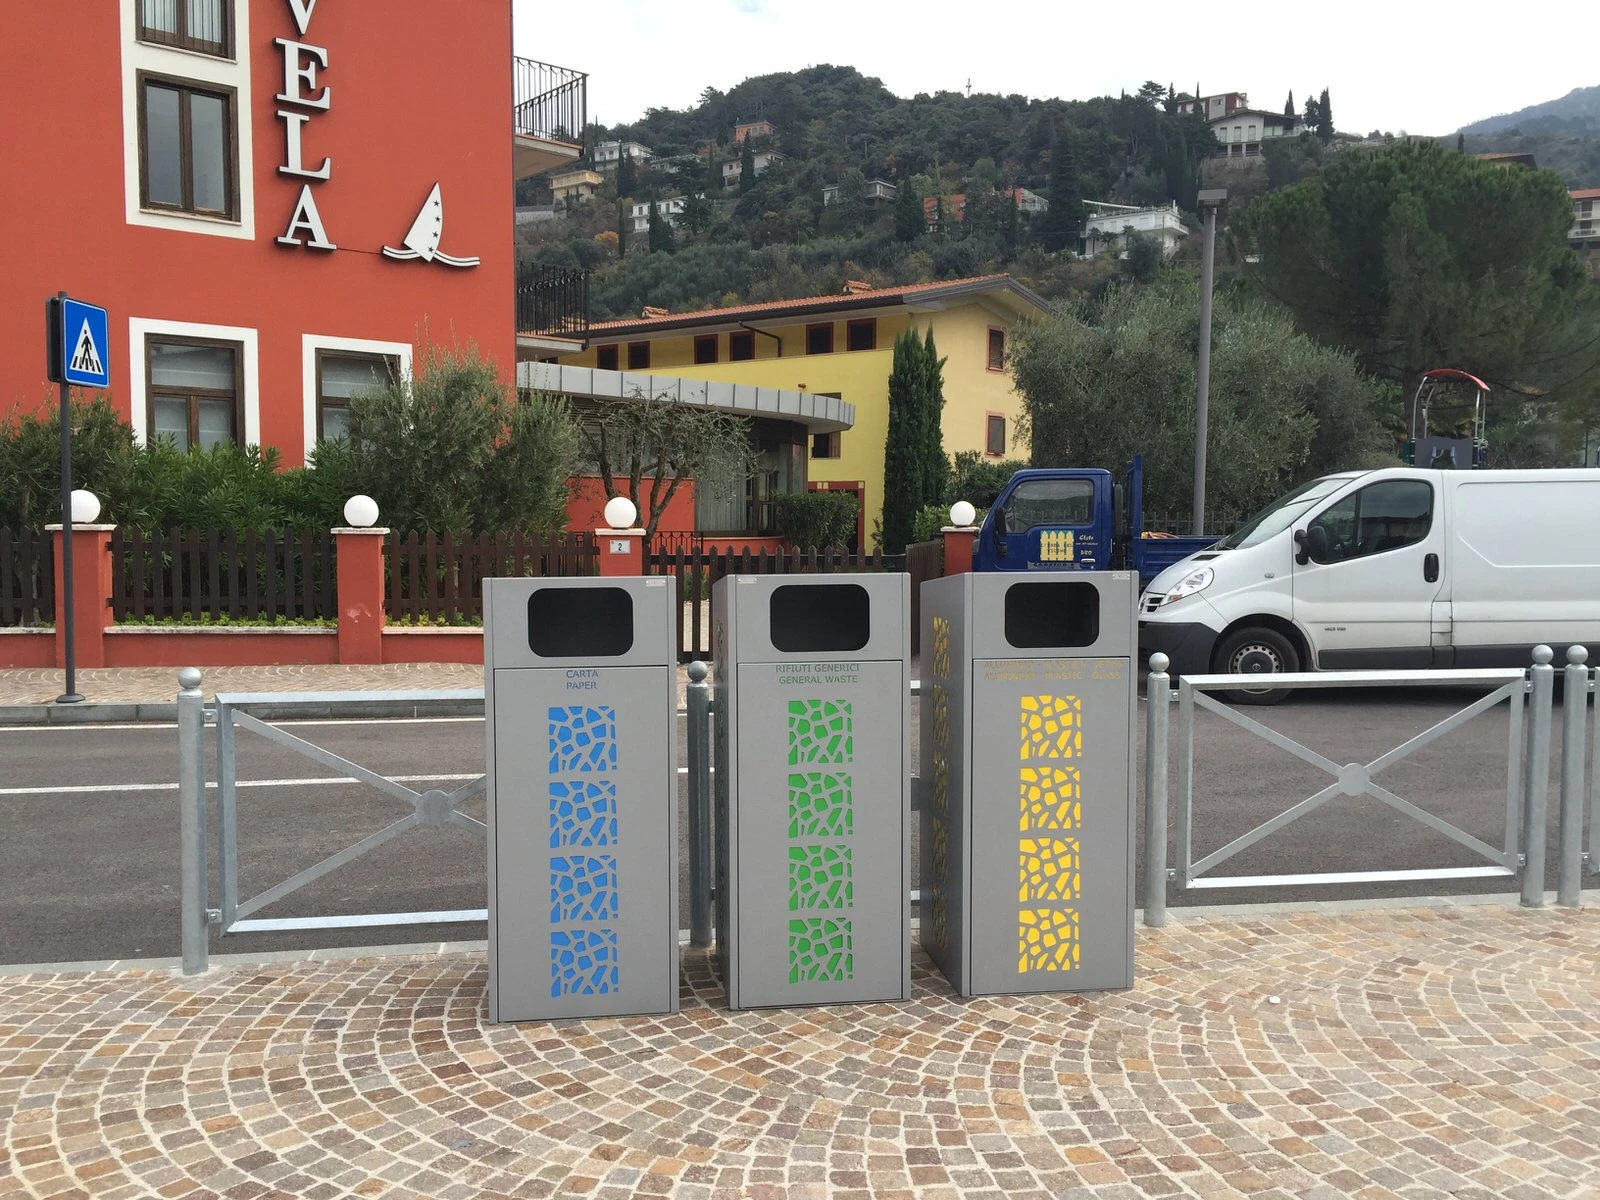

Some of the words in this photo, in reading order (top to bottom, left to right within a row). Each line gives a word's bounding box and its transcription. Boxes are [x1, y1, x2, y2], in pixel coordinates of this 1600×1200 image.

[617, 542, 623, 552] 2
[775, 664, 812, 673] RIFIUTI
[814, 663, 860, 672] GENERICI
[566, 669, 599, 678] CARTA
[779, 675, 822, 684] GENERAL
[825, 674, 858, 683] WASTE
[566, 681, 597, 690] PAPER
